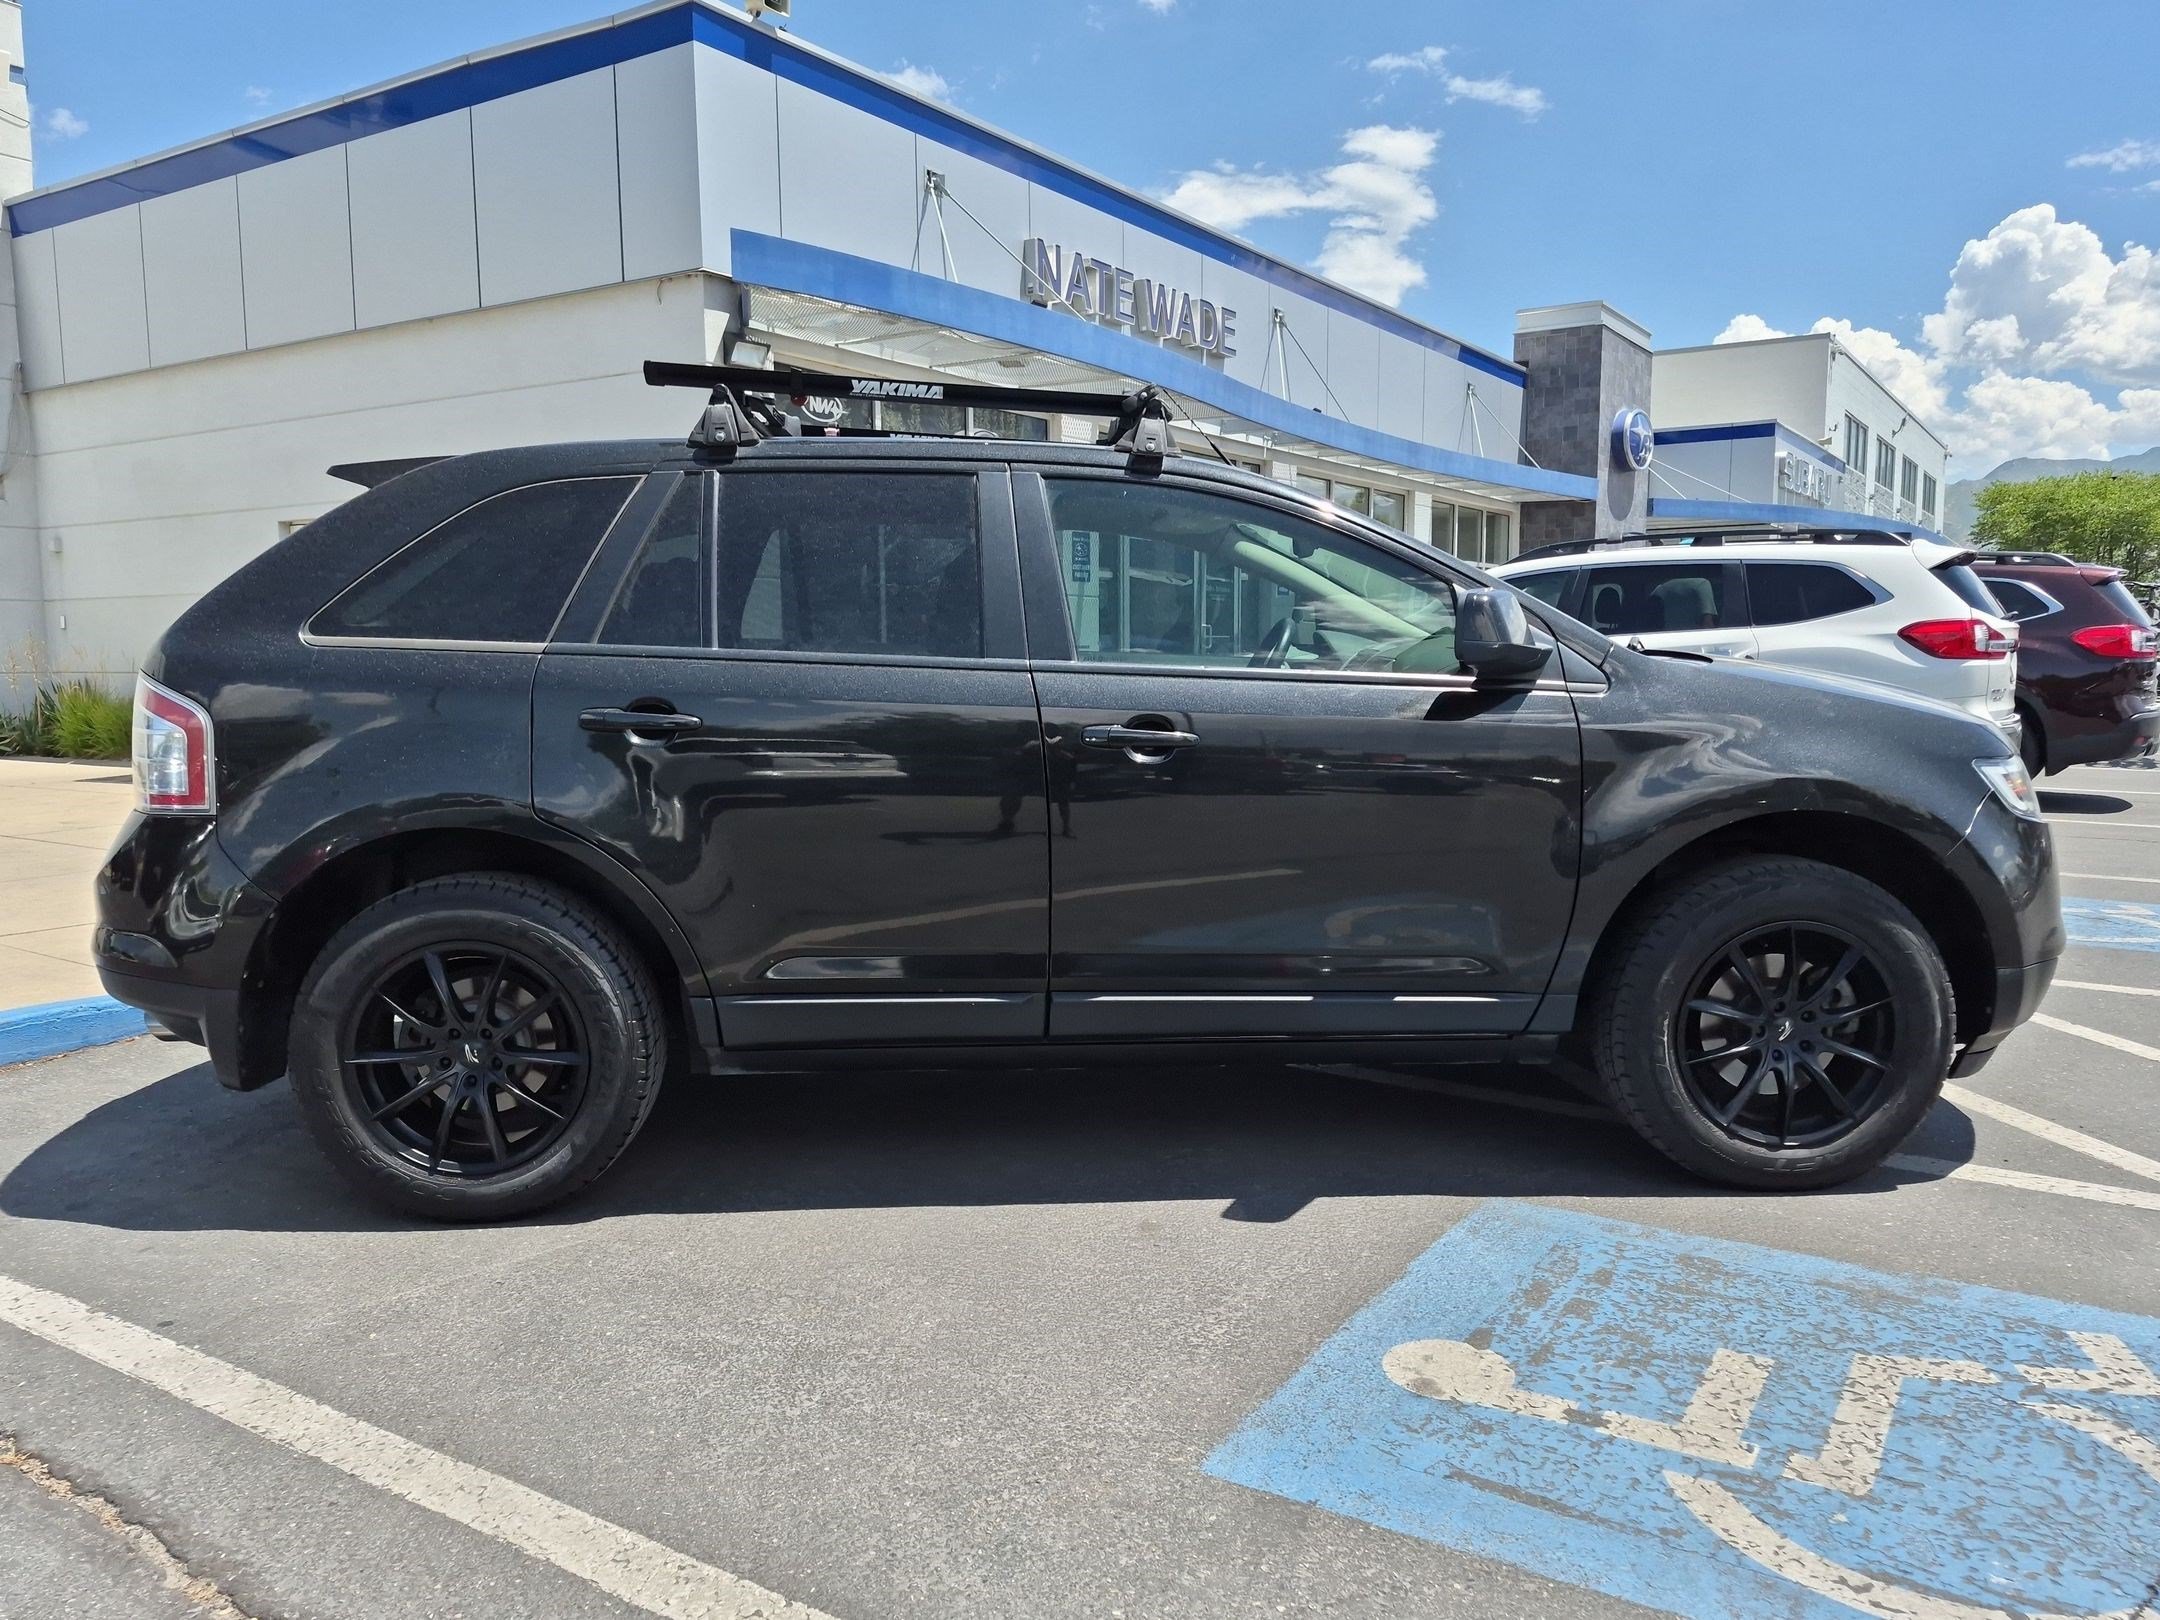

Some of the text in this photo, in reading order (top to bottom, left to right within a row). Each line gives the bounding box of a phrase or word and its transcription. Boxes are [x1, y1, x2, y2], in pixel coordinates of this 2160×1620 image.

[1028, 238, 1237, 357] NATE WADE
[851, 379, 944, 400] YAKIMA
[1784, 452, 1832, 505] SUBARU
